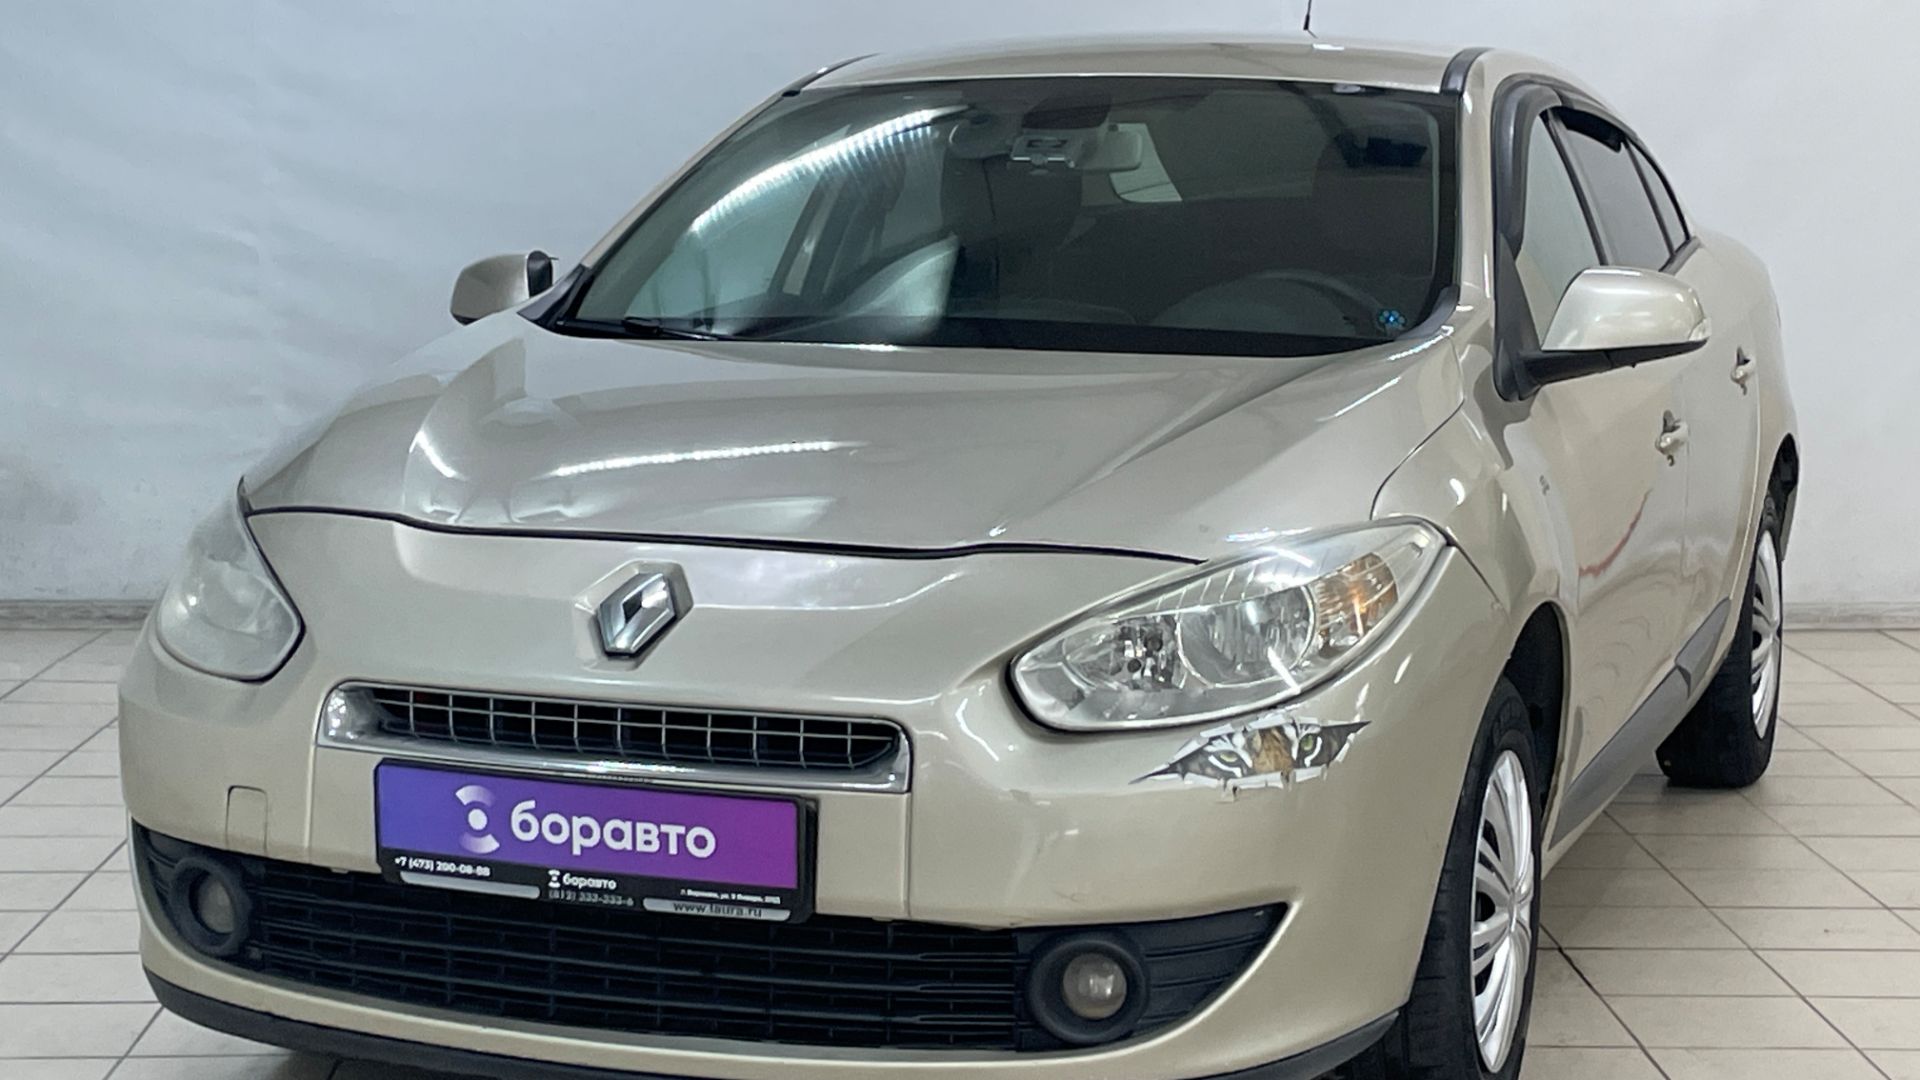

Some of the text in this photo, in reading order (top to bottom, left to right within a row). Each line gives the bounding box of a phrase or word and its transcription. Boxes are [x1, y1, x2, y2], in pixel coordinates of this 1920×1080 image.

[510, 800, 716, 858] боравто
[408, 858, 434, 872] (473)
[562, 872, 617, 890] боравто
[672, 902, 762, 918] www.laura.ru
